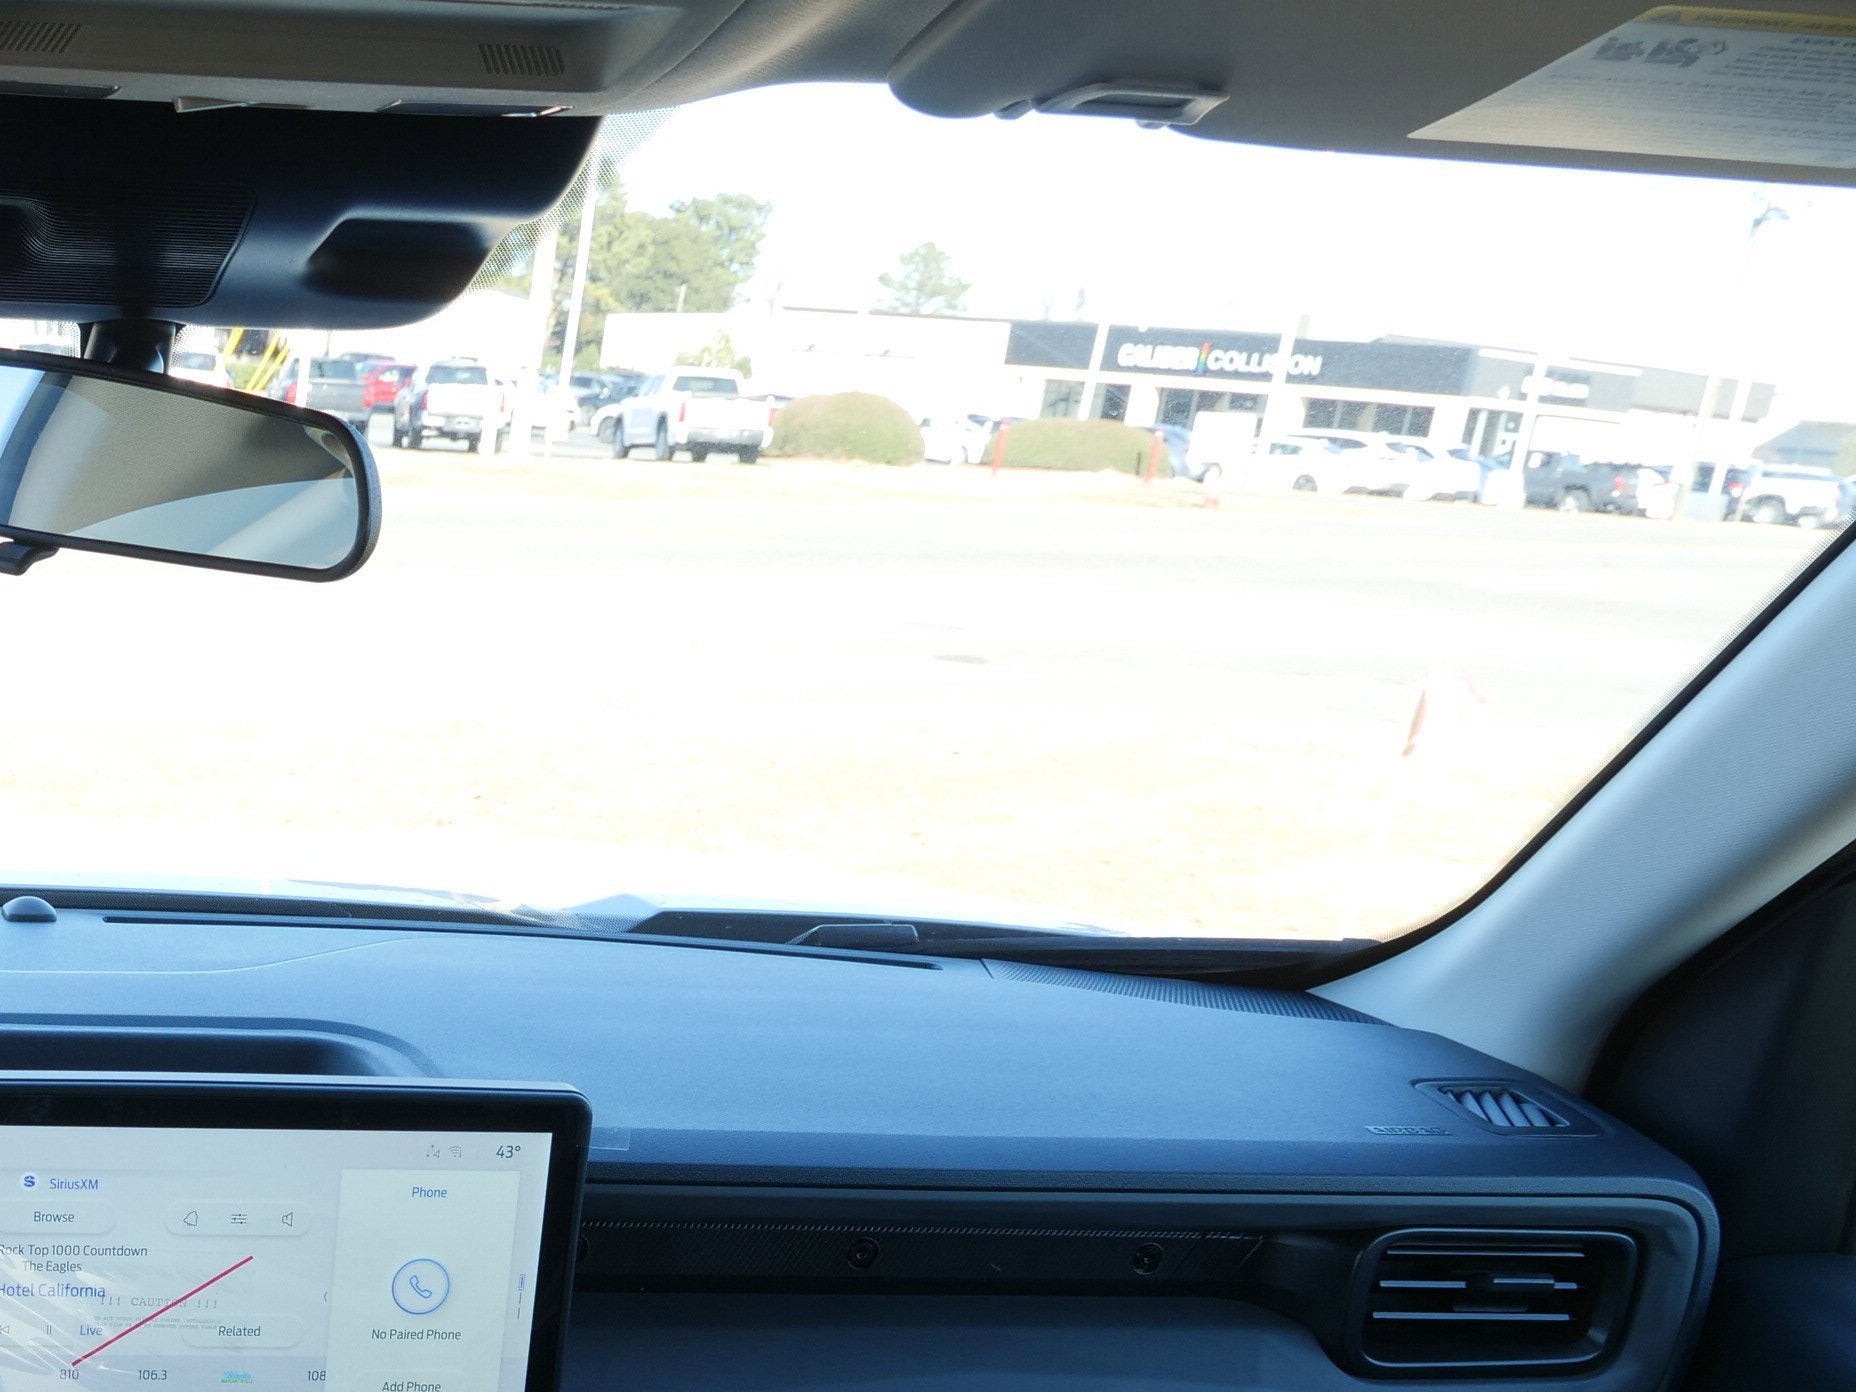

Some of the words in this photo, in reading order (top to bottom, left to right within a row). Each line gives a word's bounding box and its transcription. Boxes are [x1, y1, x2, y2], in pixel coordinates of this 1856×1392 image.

[1206, 350, 1322, 376] COLLISON
[496, 1144, 521, 1159] 43°
[49, 1177, 99, 1190] SiriusXM
[411, 1186, 447, 1198] Phone
[33, 1210, 75, 1223] Browse
[28, 1245, 49, 1258] Top
[51, 1245, 80, 1256] 1000
[82, 1245, 148, 1258] Countdown
[22, 1260, 43, 1272] The
[46, 1261, 82, 1274] Eagles
[38, 1283, 106, 1298] California
[79, 1324, 103, 1336] Live
[218, 1325, 261, 1337] Related
[371, 1329, 389, 1340] No
[392, 1328, 422, 1340] Paired
[425, 1329, 461, 1341] Phone
[59, 1369, 79, 1380] 810
[138, 1369, 167, 1381] 106.3
[382, 1381, 402, 1392] Add
[405, 1381, 442, 1392] Phone
